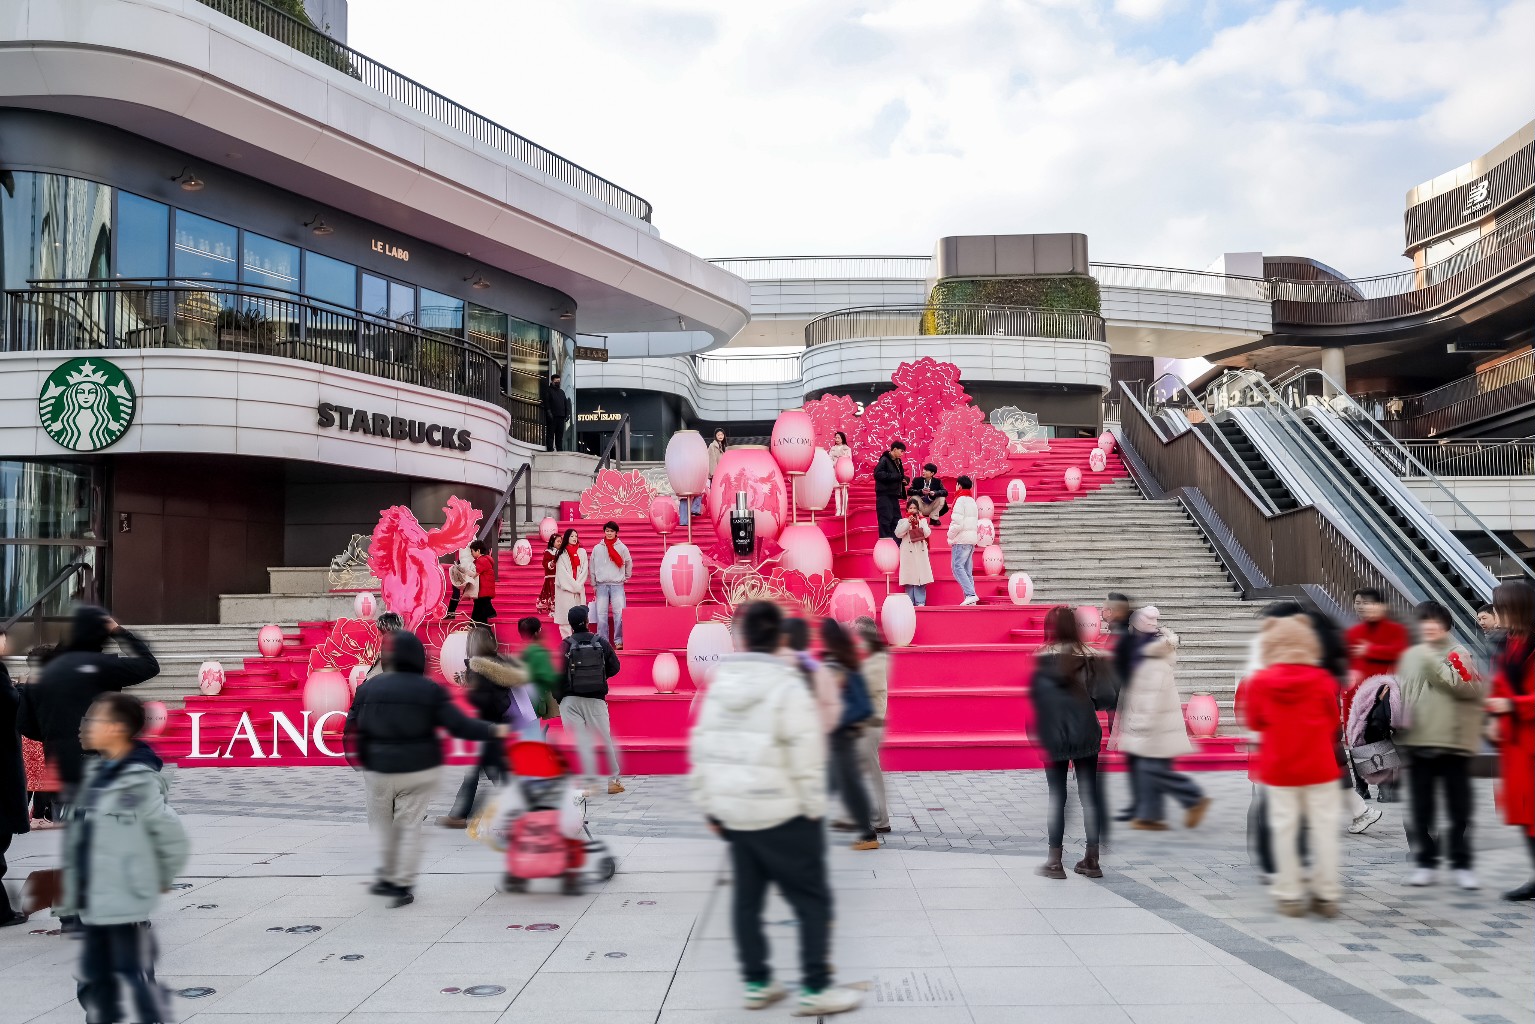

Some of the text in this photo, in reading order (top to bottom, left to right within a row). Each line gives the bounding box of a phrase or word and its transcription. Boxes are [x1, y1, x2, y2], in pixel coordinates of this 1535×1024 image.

[371, 239, 410, 262] LE LABO
[317, 402, 472, 452] STARBUCKS
[577, 413, 622, 422] STONE ISLAND
[186, 710, 349, 759] LANC
